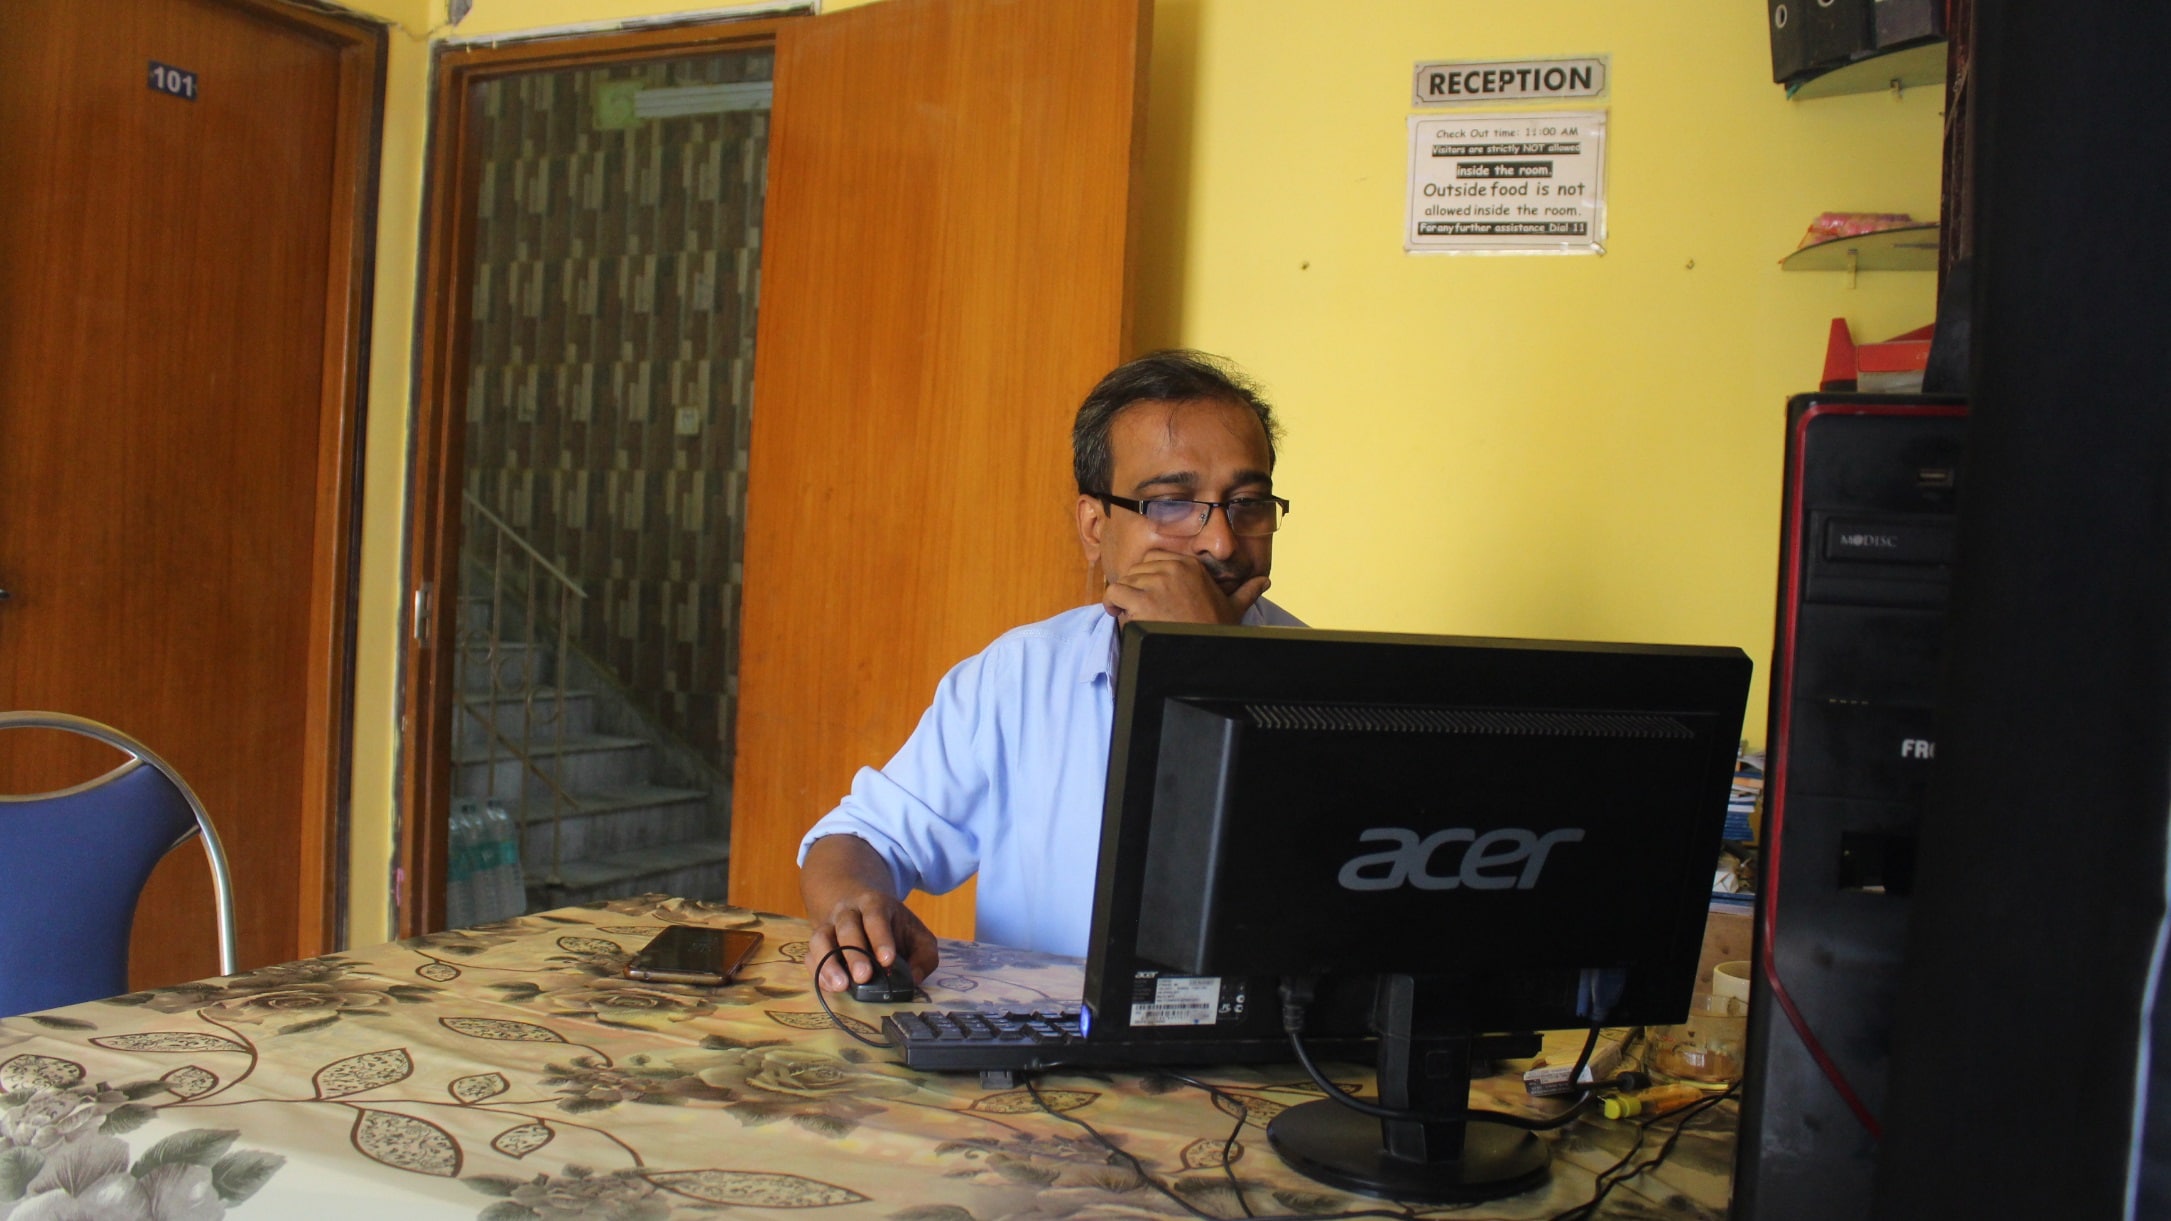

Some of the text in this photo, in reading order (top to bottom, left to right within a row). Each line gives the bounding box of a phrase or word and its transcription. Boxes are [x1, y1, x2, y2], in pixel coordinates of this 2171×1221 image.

[153, 66, 193, 97] 101
[1429, 65, 1592, 96] RECEPTION
[1436, 127, 1579, 139] Check Out time: 11:00 AM
[1432, 144, 1466, 154] Visitors
[1468, 145, 1484, 153] are
[1487, 144, 1522, 155] strictly
[1523, 143, 1546, 153] NOT
[1456, 164, 1552, 176] inside the room.
[1423, 181, 1586, 197] Outside food is not
[1424, 204, 1582, 216] allowed inside the room.
[1455, 222, 1491, 233] further
[1494, 222, 1546, 233] assistance
[1550, 222, 1568, 232] Dial
[1573, 222, 1585, 232] 11
[1337, 827, 1586, 891] acer
[1134, 971, 1159, 979] acer
